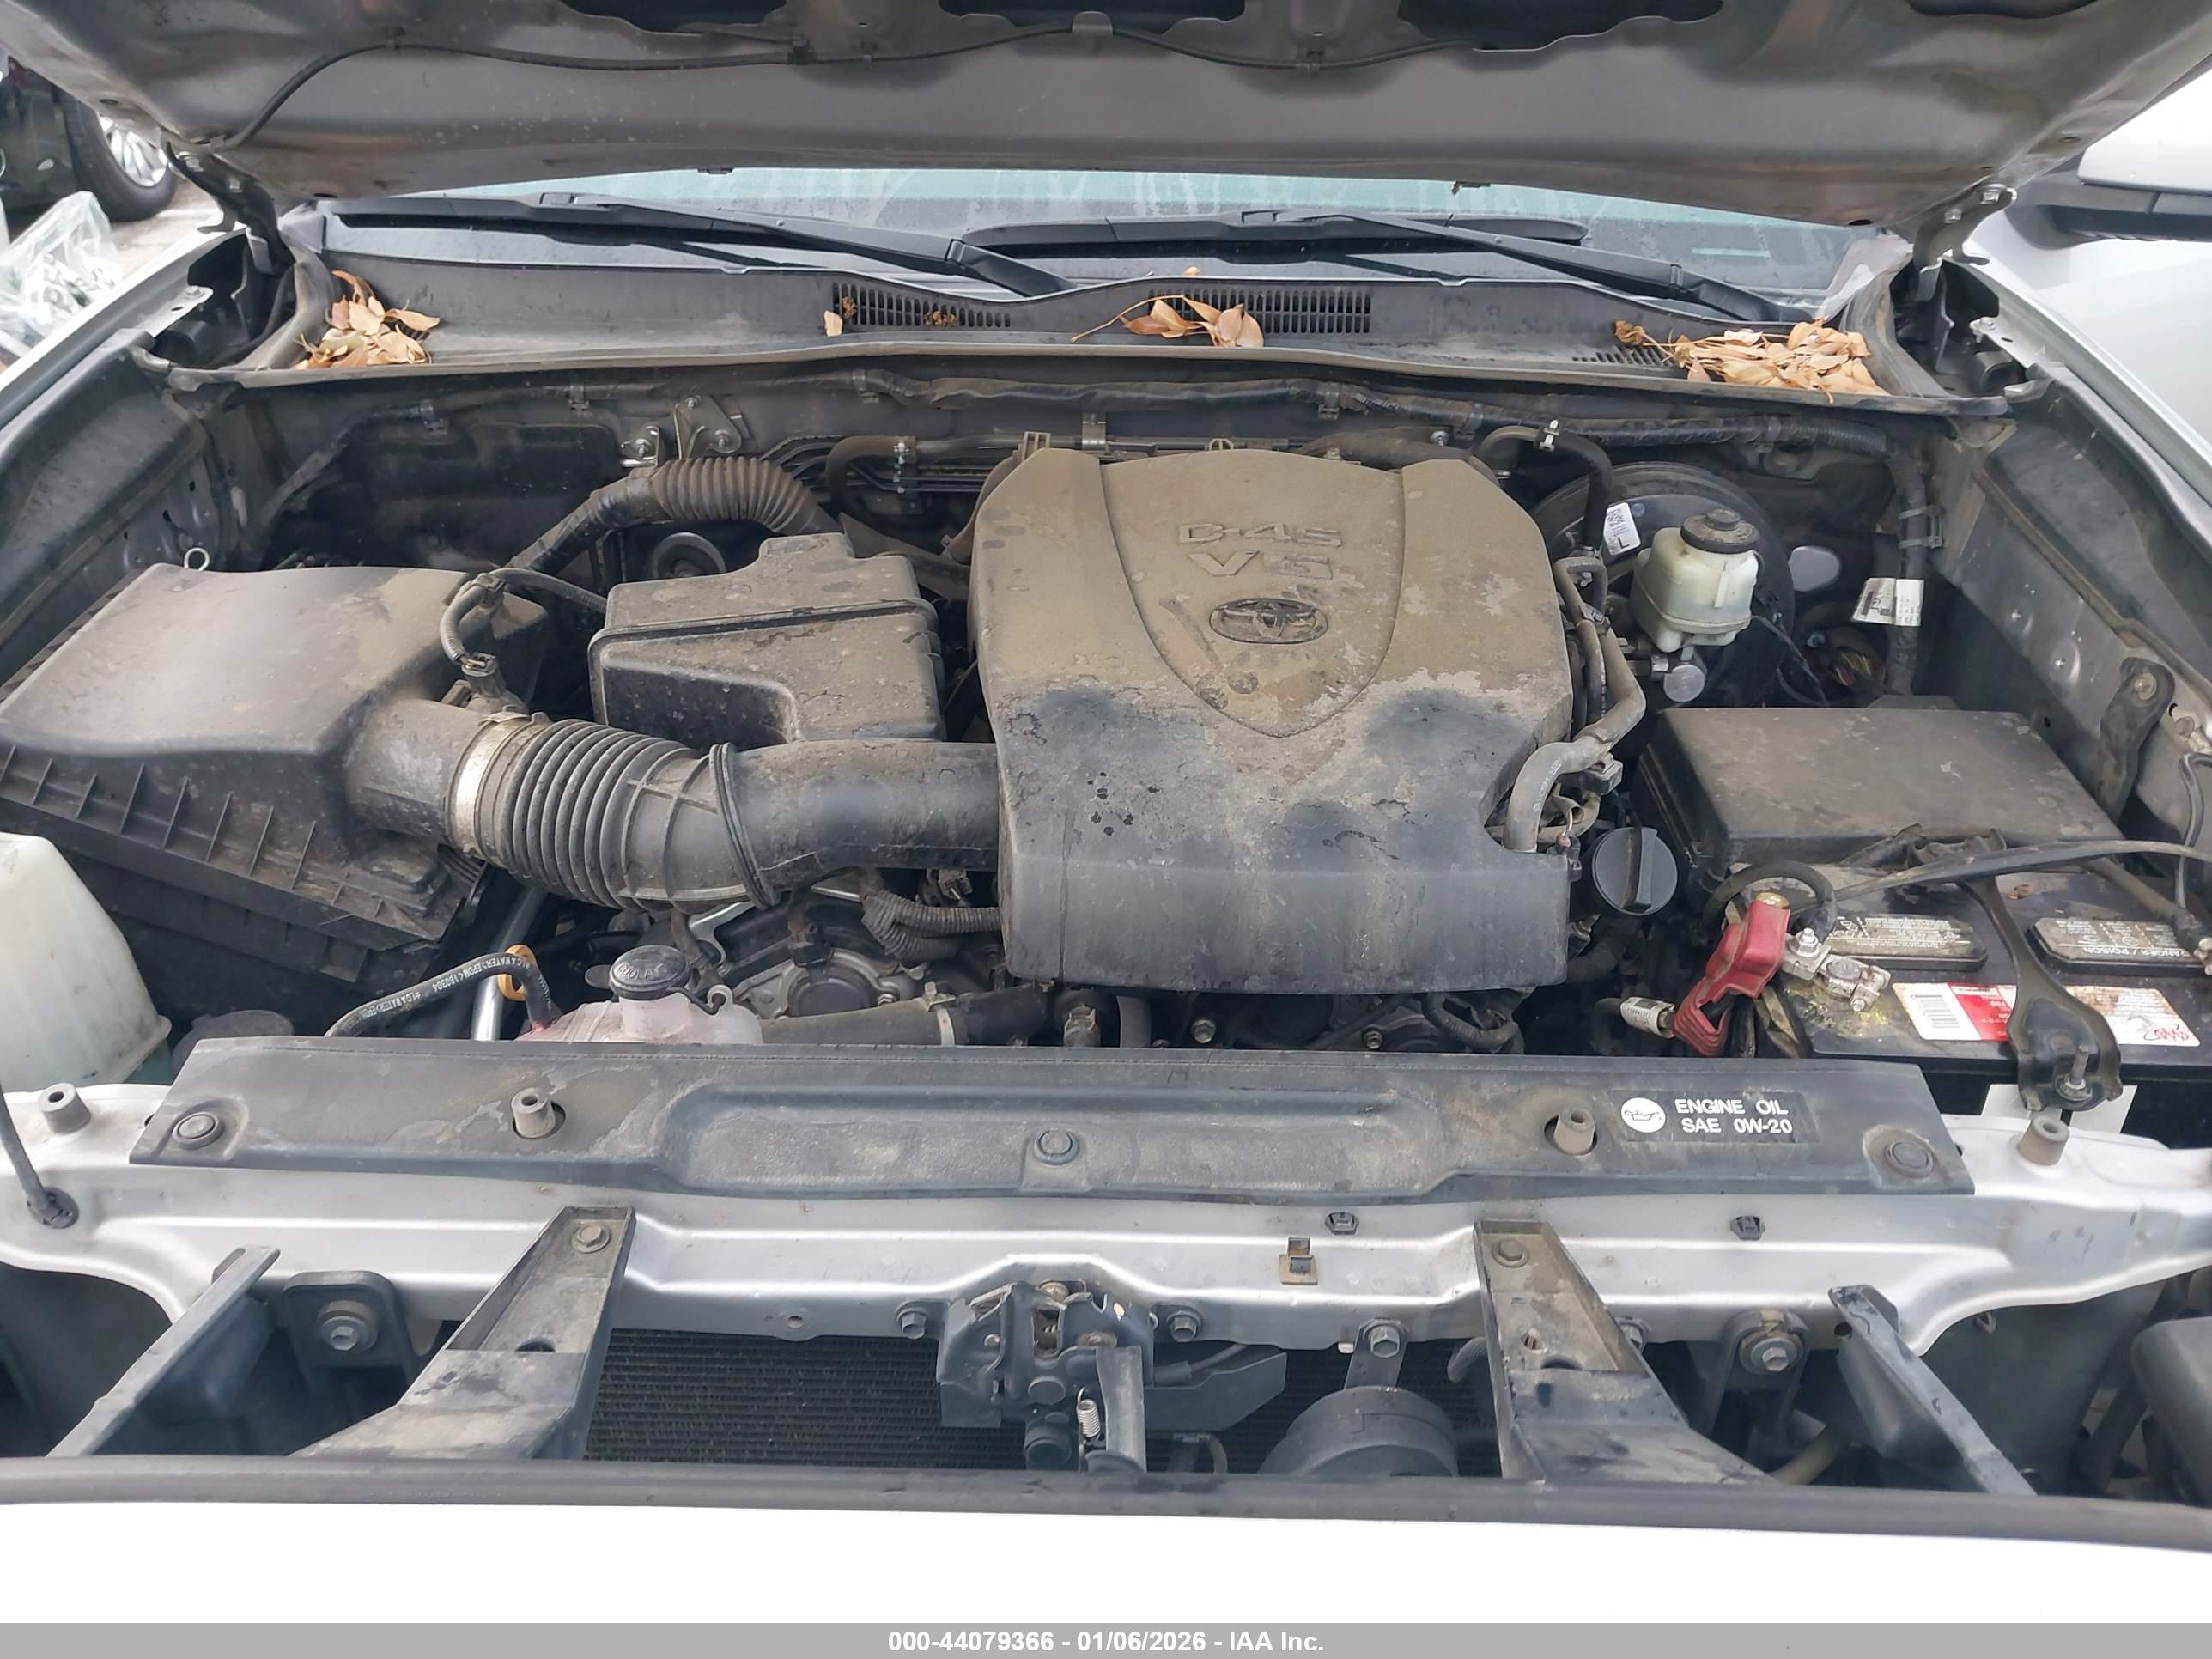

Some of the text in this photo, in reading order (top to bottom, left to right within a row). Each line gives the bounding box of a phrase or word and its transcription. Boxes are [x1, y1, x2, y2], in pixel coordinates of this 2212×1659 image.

[1675, 1098, 1789, 1115] ENGINE OIL
[1680, 1117, 1793, 1134] SAE 0W-20
